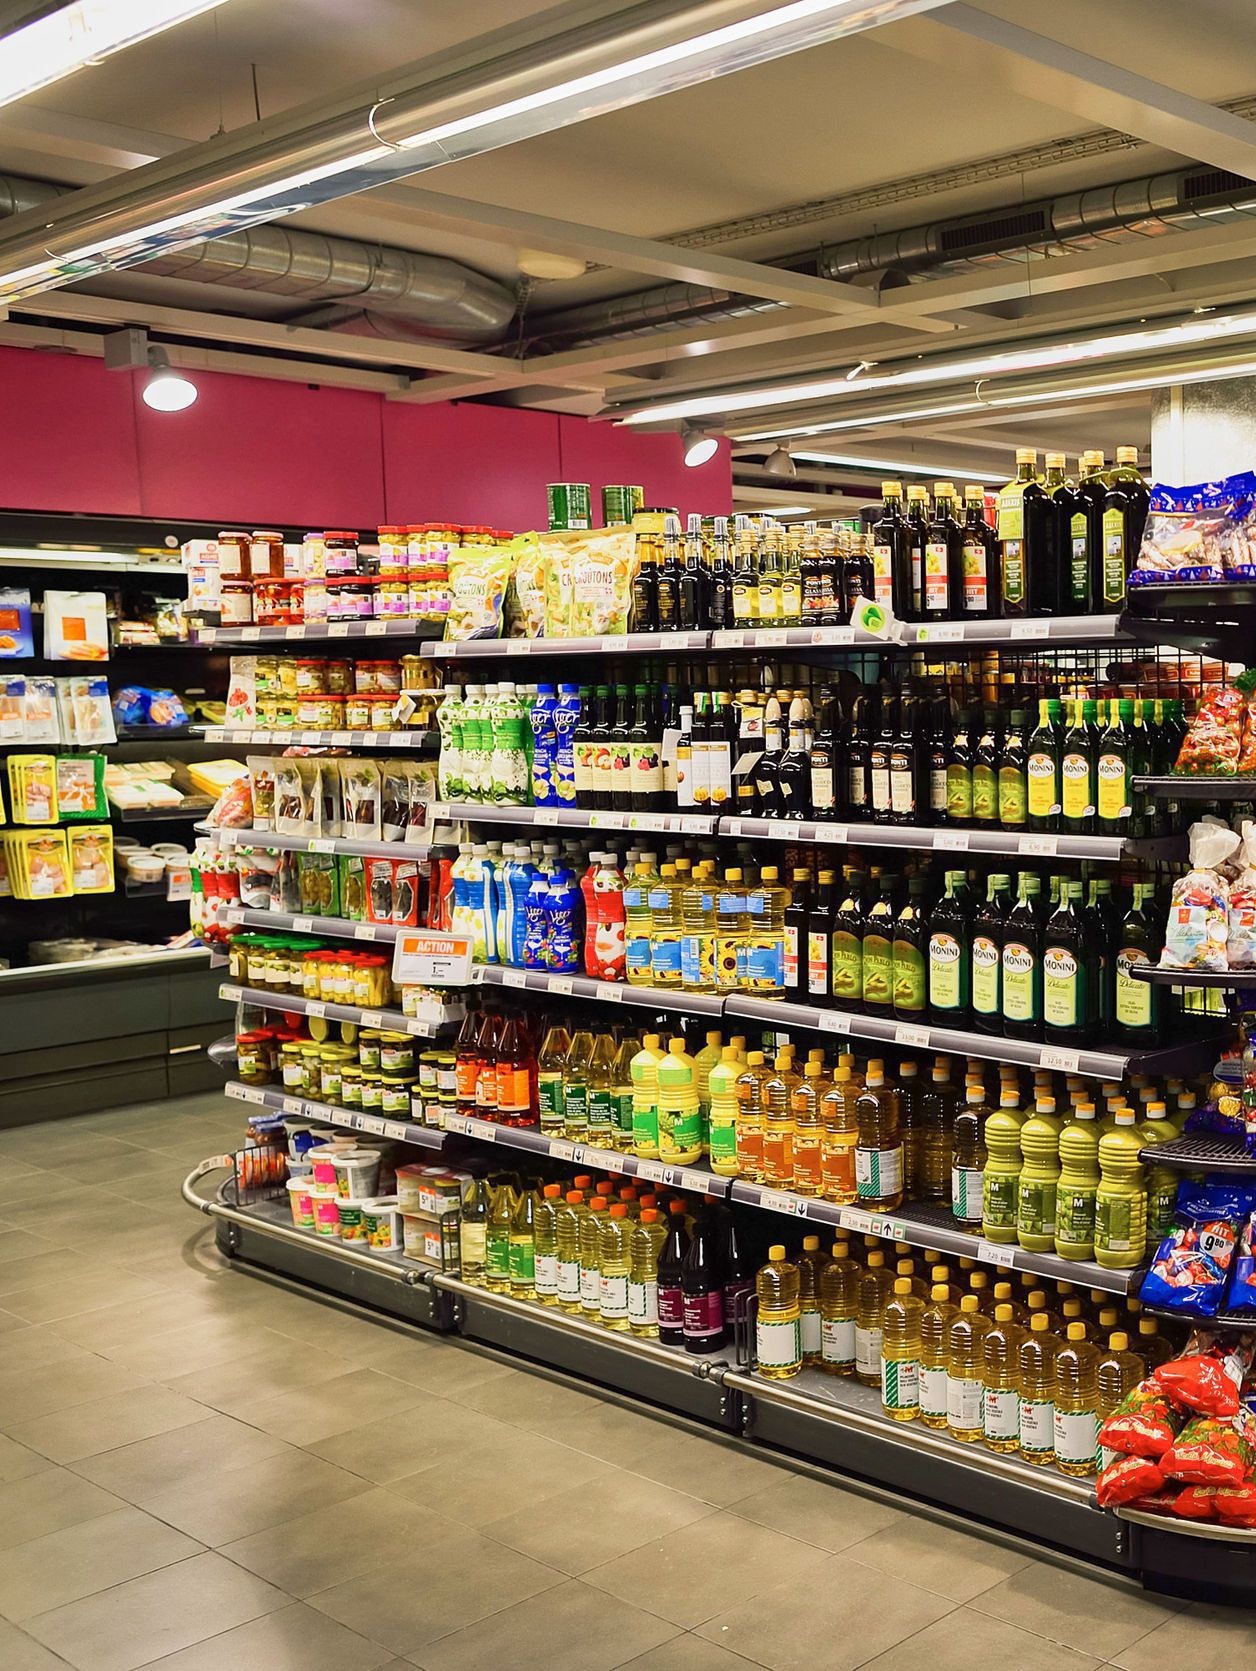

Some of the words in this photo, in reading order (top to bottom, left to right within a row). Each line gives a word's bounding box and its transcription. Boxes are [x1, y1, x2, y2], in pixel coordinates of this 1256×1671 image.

[1029, 764, 1053, 773] MONINI
[1063, 765, 1088, 773] MONINI
[1099, 765, 1124, 774] MONINI
[416, 941, 454, 954] ACTION
[931, 945, 958, 957] MONINI
[974, 948, 996, 961] MONINI
[1004, 954, 1031, 967] MONINI
[1046, 960, 1075, 972] MONINI
[674, 1118, 683, 1126] M
[990, 1182, 999, 1191] M
[1022, 1189, 1029, 1198] M
[1074, 1198, 1083, 1207] M
[1160, 1197, 1169, 1205] M
[1211, 1223, 1230, 1236] HIT
